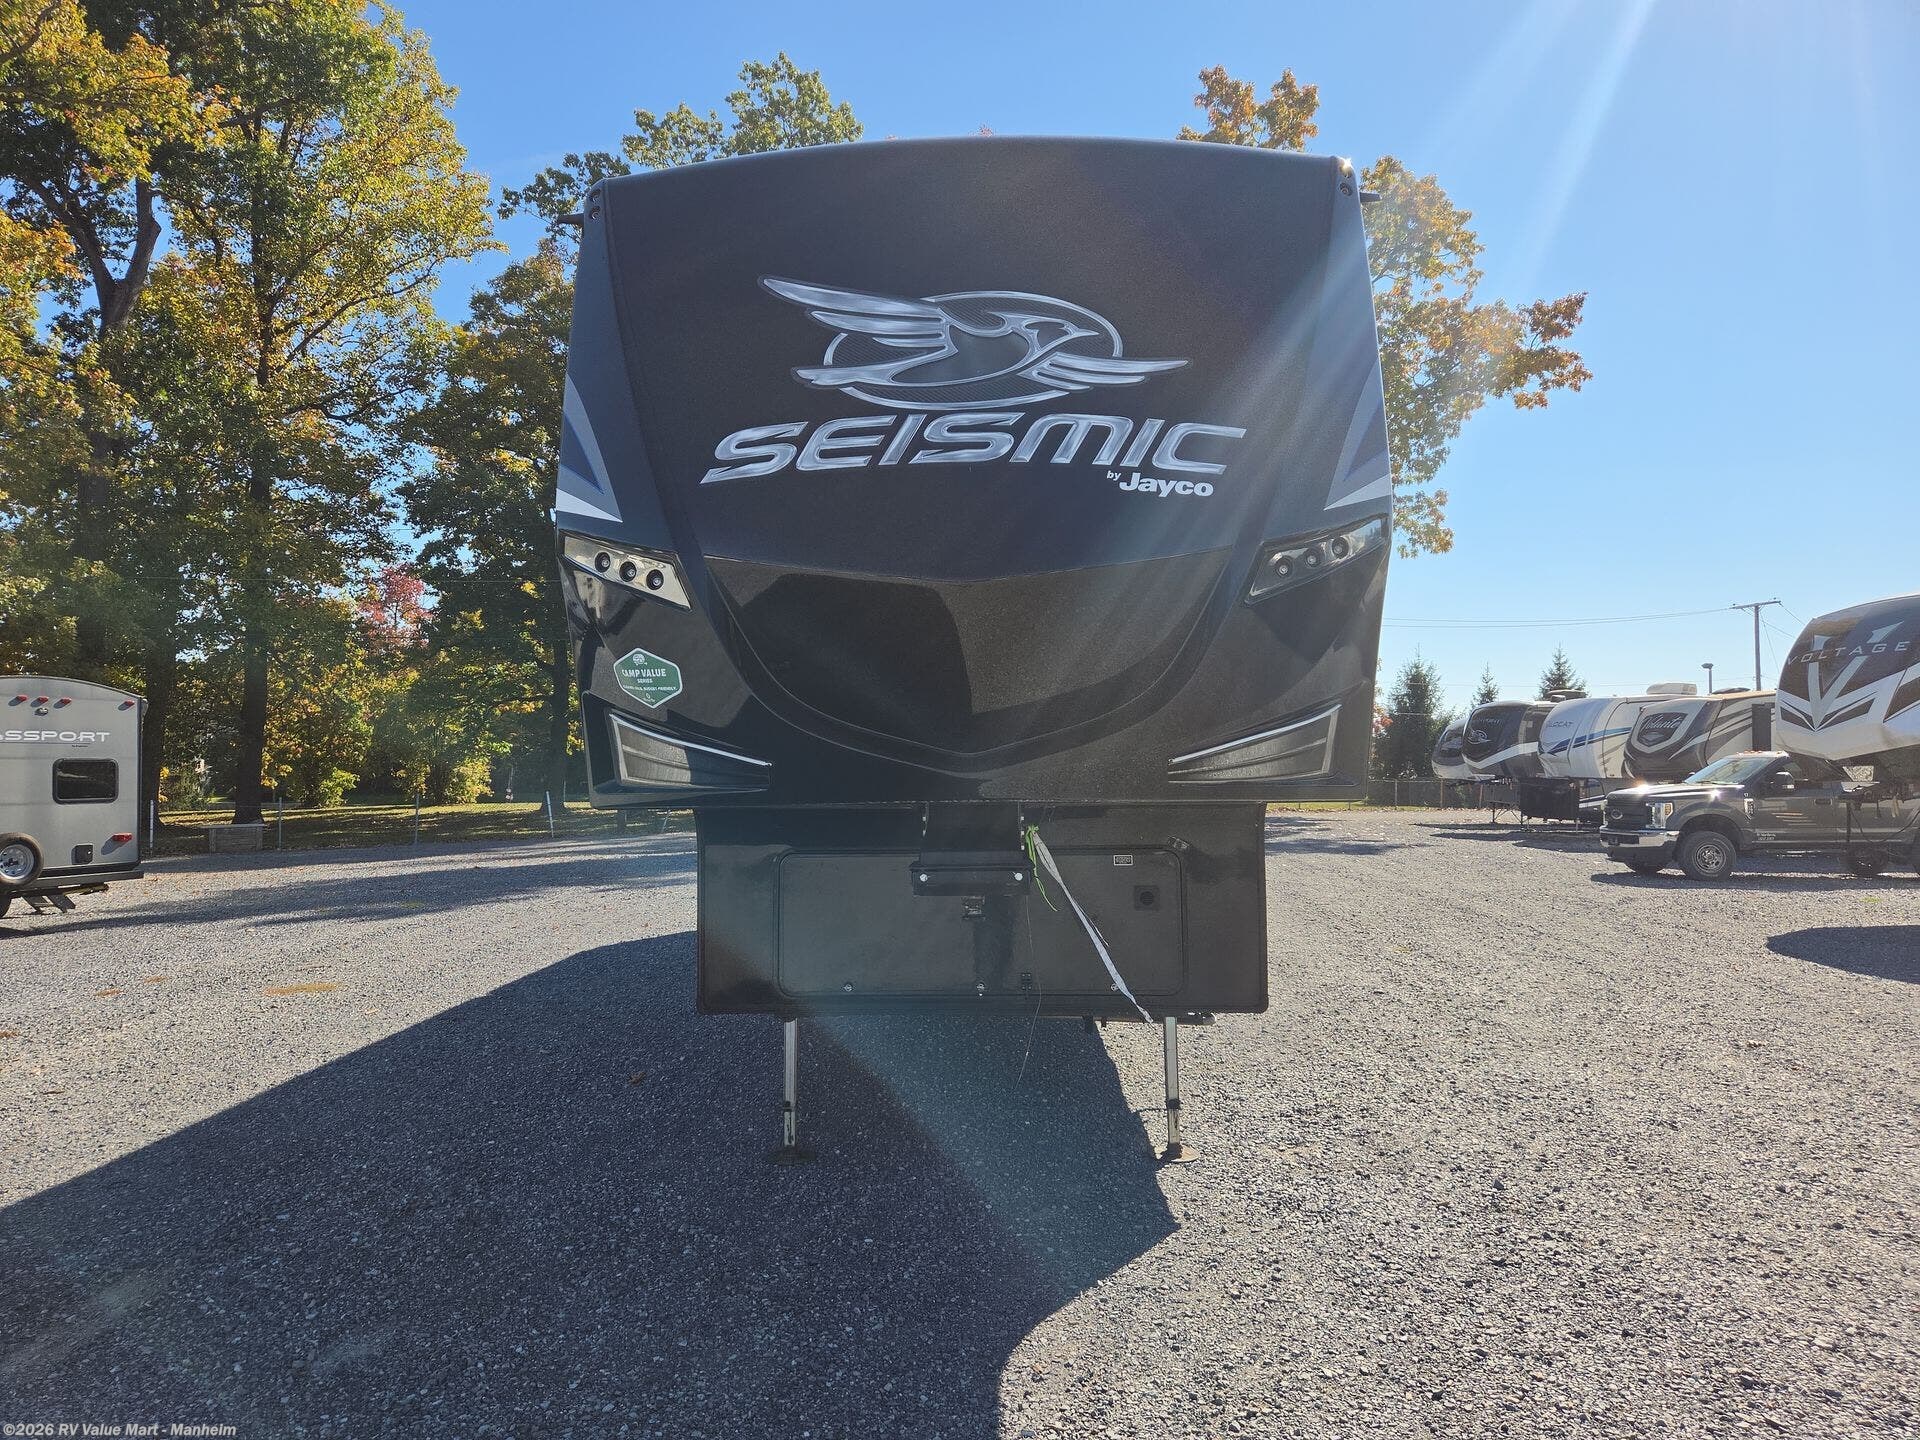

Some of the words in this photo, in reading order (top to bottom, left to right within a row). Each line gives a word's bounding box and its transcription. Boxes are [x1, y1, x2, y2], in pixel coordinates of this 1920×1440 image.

[700, 412, 1247, 484] SEISMIC
[1106, 470, 1121, 481] by
[1119, 472, 1214, 498] Jayco
[1786, 641, 1911, 665] VOLTAGE
[641, 669, 666, 677] VALUE
